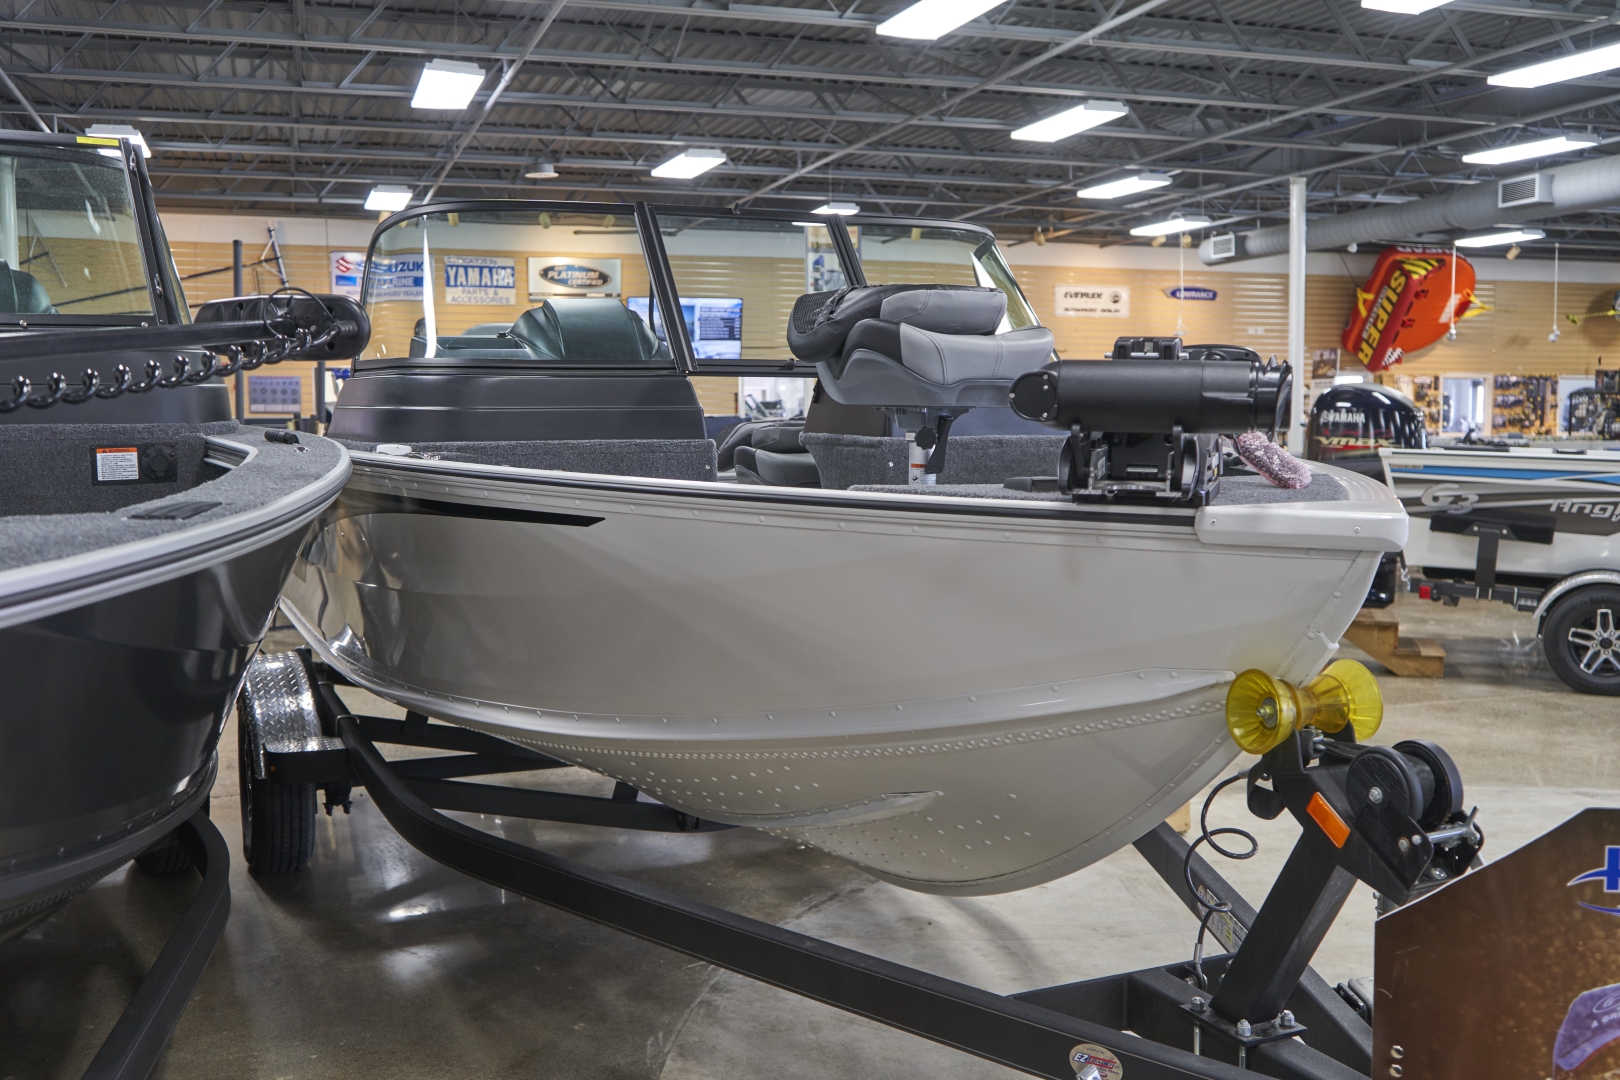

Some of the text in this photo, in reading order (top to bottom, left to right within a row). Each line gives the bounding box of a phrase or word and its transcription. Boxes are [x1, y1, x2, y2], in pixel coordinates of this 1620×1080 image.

[446, 266, 515, 287] YAMAHA
[547, 270, 600, 280] PLATINUM
[461, 288, 490, 296] PARTS
[450, 296, 511, 304] ACCESSORIES
[1357, 269, 1407, 366] SUPER
[1328, 410, 1366, 424] YAMAHA
[1420, 482, 1480, 515] G3
[1073, 1052, 1089, 1063] EZ
